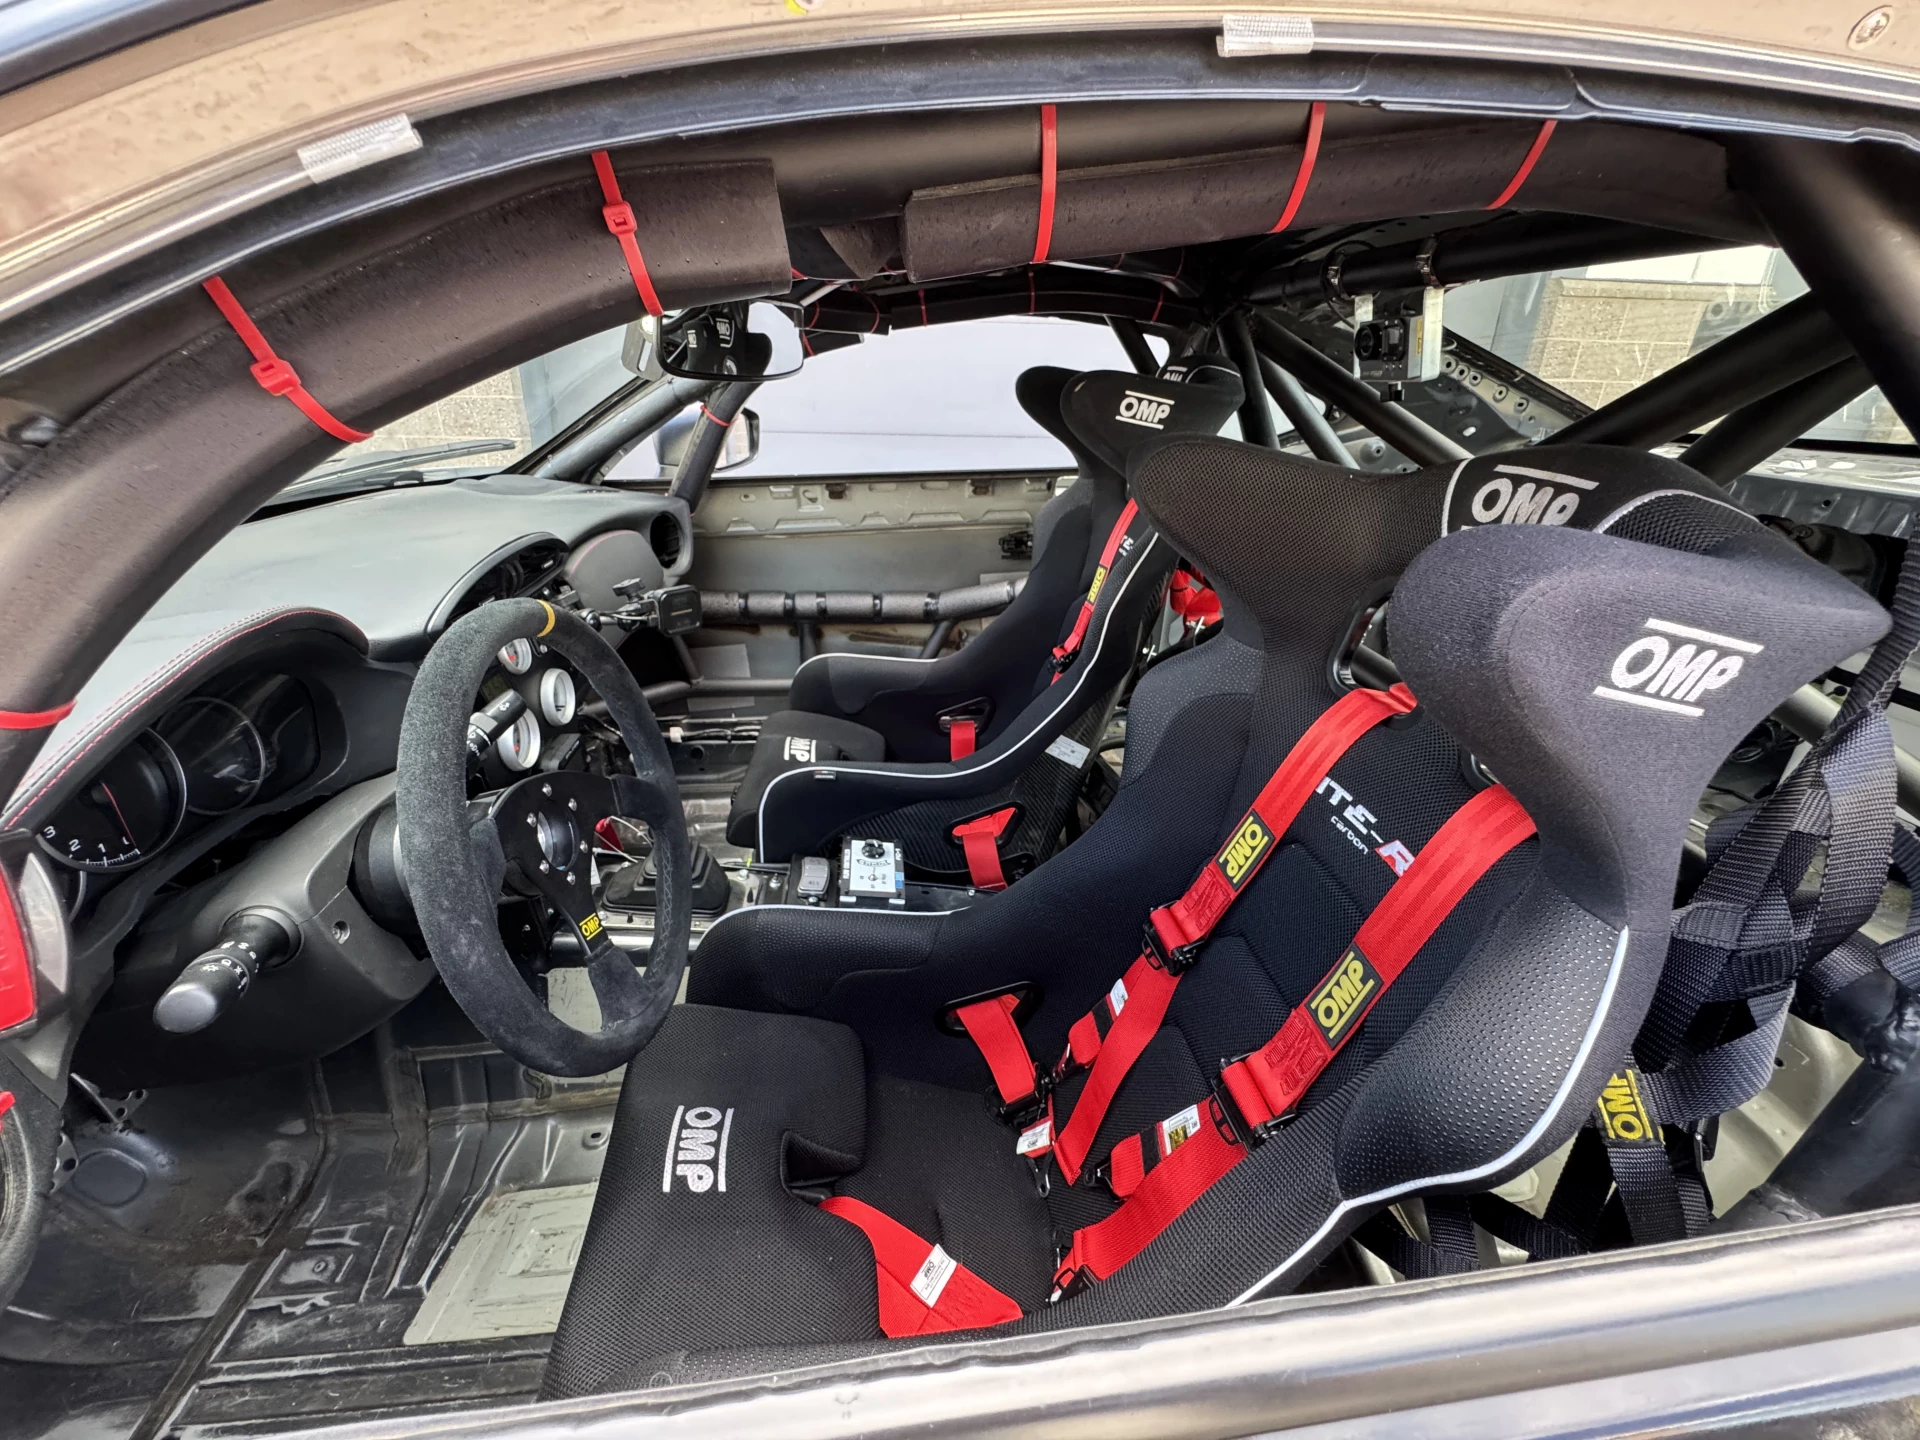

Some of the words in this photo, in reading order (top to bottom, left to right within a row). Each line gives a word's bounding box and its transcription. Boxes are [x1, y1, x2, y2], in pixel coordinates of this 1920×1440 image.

[1119, 397, 1170, 424] OMP
[1472, 478, 1579, 525] OMP
[1611, 636, 1743, 701] OMP
[43, 825, 56, 839] 3
[69, 838, 81, 852] 2
[98, 843, 106, 853] 1
[1226, 823, 1262, 878] OMP
[1331, 815, 1368, 854] carbon
[582, 916, 599, 937] OMP
[1317, 960, 1364, 1028] OMP
[675, 1107, 722, 1193] OMP
